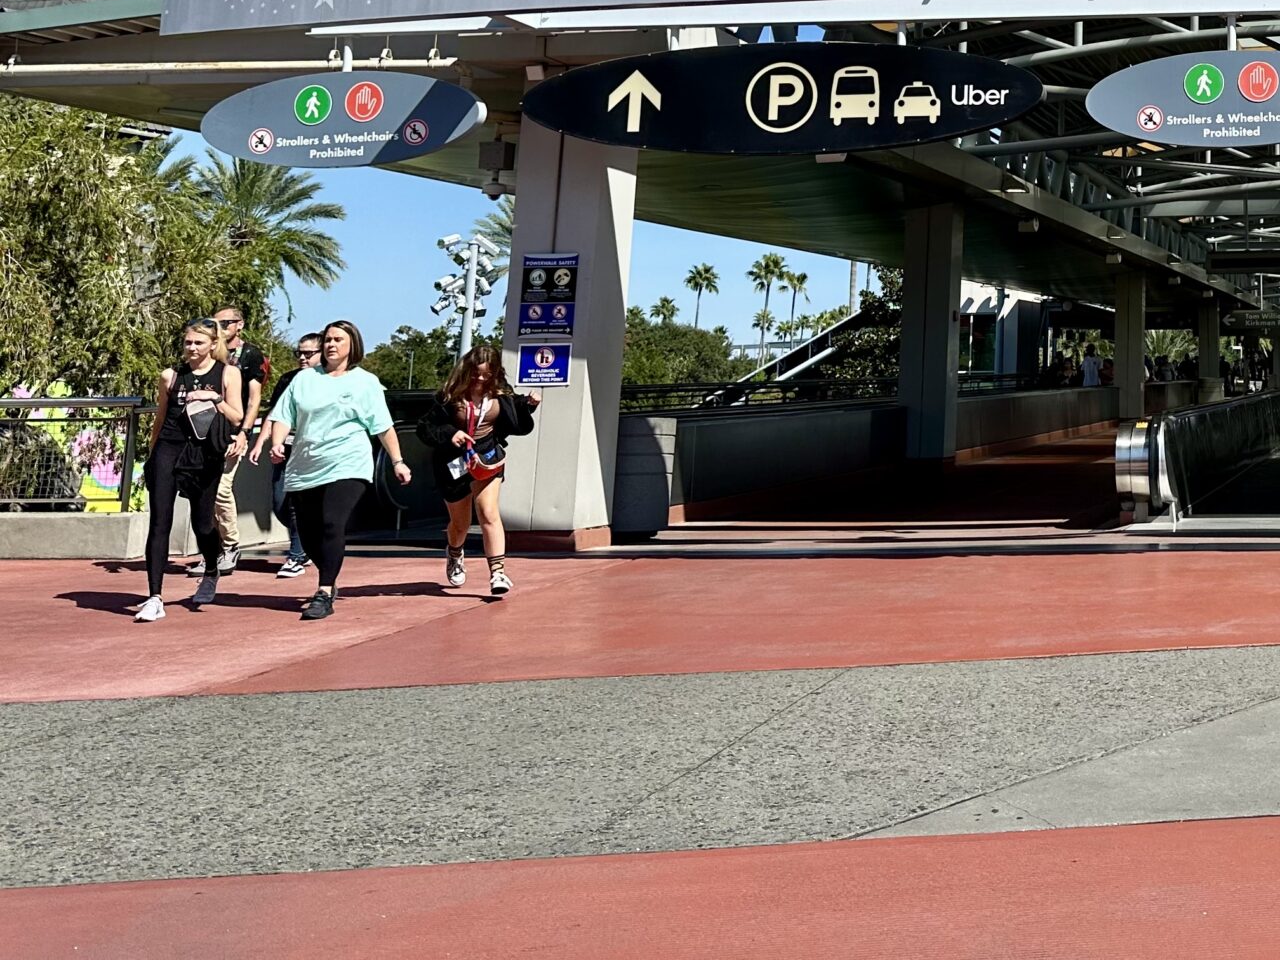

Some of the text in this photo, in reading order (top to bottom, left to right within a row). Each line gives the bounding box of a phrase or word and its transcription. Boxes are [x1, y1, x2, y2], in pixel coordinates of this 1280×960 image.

[768, 74, 1010, 121] P Uber
[1167, 113, 1212, 125] Strollers
[1215, 114, 1225, 124] &
[1203, 126, 1260, 138] Prohibited
[276, 131, 399, 147] Strollers & Wheelchairs
[309, 146, 363, 159] Prohibited
